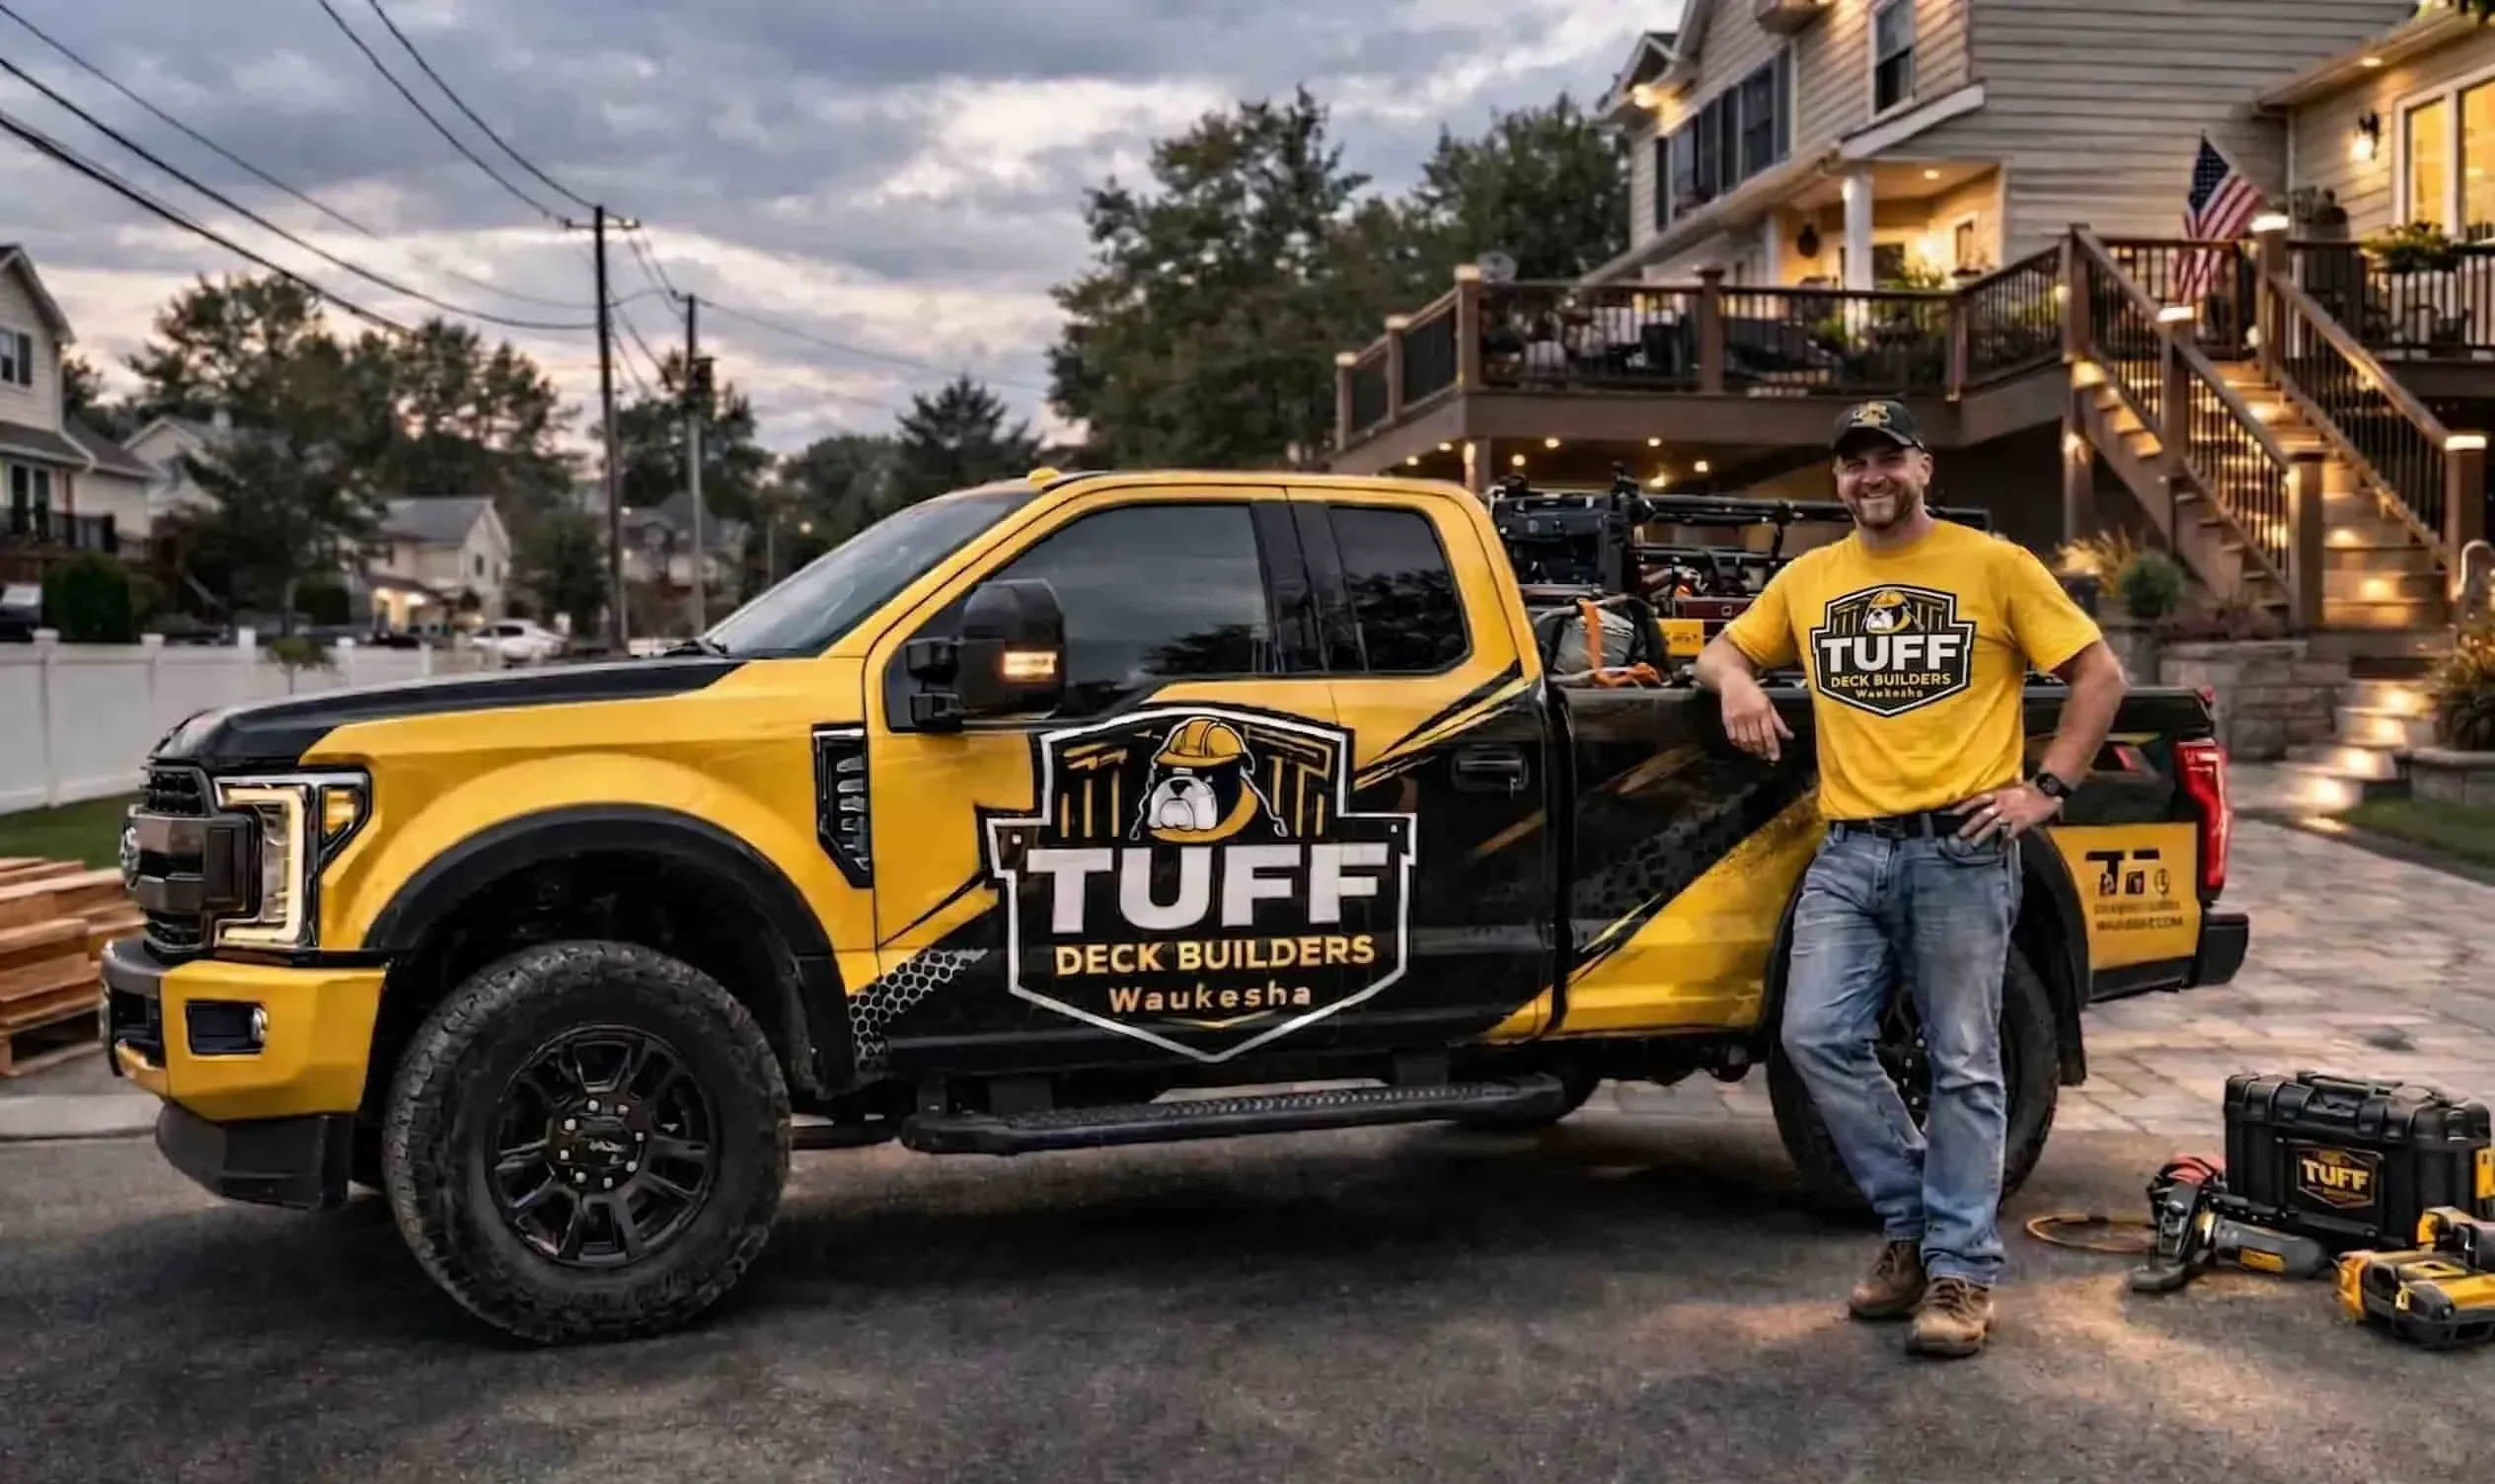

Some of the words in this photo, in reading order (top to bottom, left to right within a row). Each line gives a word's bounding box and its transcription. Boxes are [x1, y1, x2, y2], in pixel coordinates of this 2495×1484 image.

[1821, 634, 1960, 672] TUFF
[1832, 675, 1868, 688] DECK
[1873, 673, 1951, 687] BUILDERS
[1027, 843, 1388, 933] TUFF
[1055, 943, 1165, 975] DECK
[1178, 936, 1375, 971] BUILDERS
[1109, 981, 1311, 1012] Waukesha
[2303, 1159, 2369, 1189] TUFF
